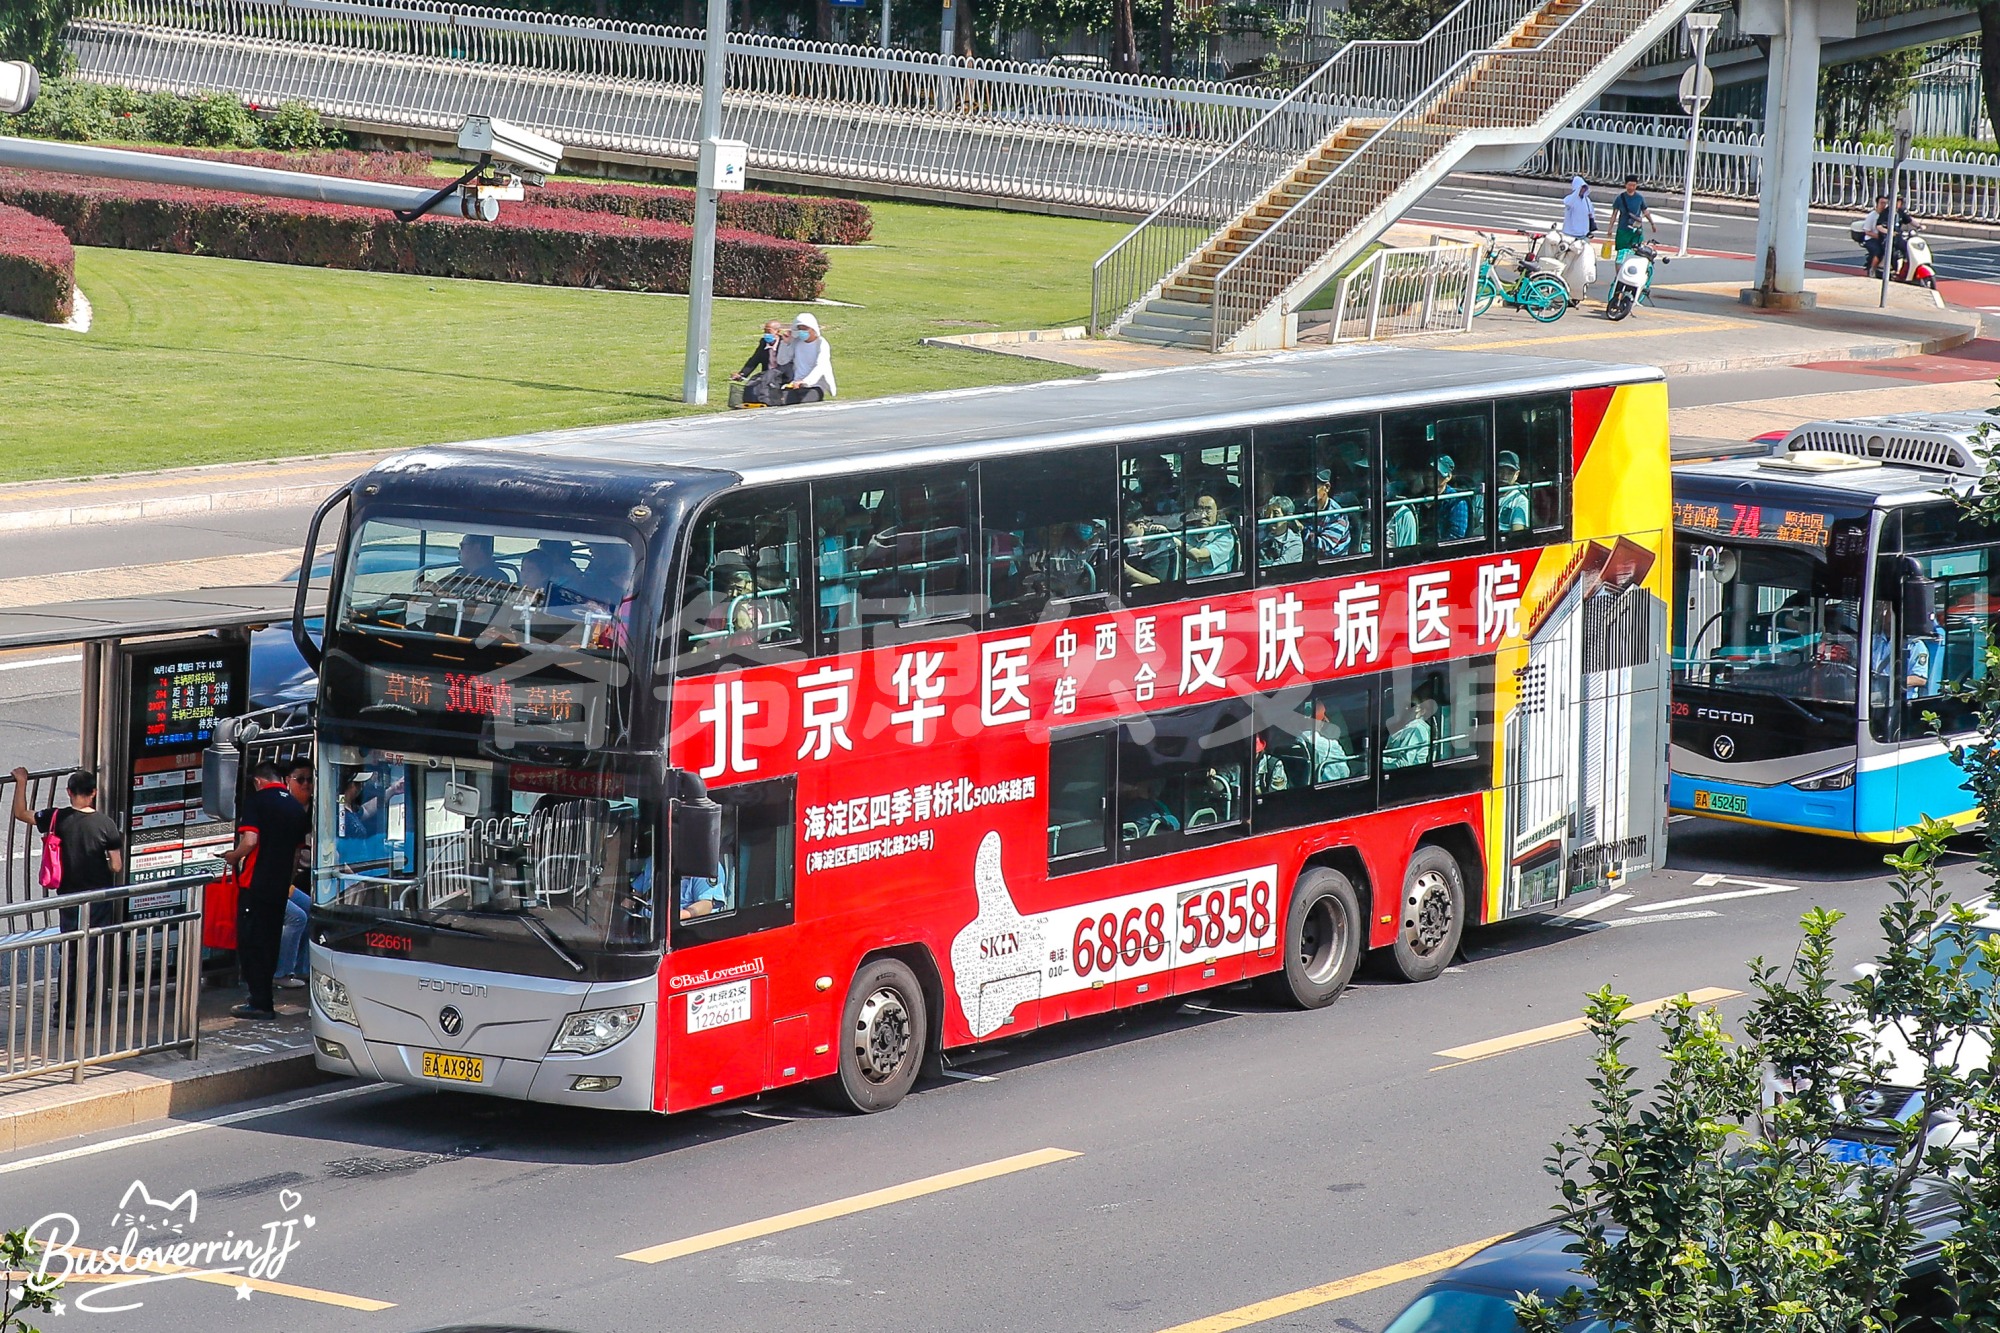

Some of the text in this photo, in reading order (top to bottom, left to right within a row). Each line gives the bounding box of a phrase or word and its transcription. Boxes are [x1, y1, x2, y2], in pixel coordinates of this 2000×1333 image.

[1730, 504, 1760, 538] 74
[1785, 511, 1824, 529] 颐和园
[1777, 525, 1829, 547] 新建宫门
[1178, 559, 1521, 697] 皮肤病医院
[385, 673, 432, 705] 草桥
[525, 687, 572, 720] 草桥
[699, 615, 1157, 779] 北京华医 中西医
[1053, 662, 1157, 716] 结合
[1697, 708, 1754, 725] FOTON
[803, 776, 1036, 842] 海淀区四季青桥北500米路西
[1695, 792, 1747, 813] 京A45245D
[806, 829, 934, 875] (海淀区西四环北路29号)
[365, 932, 412, 952] 1226611
[1073, 880, 1270, 977] 6868 5858
[980, 931, 1020, 960] SKIN
[418, 977, 488, 998] FOTON
[708, 986, 747, 1003] 北京公交
[696, 1006, 742, 1029] 1226611
